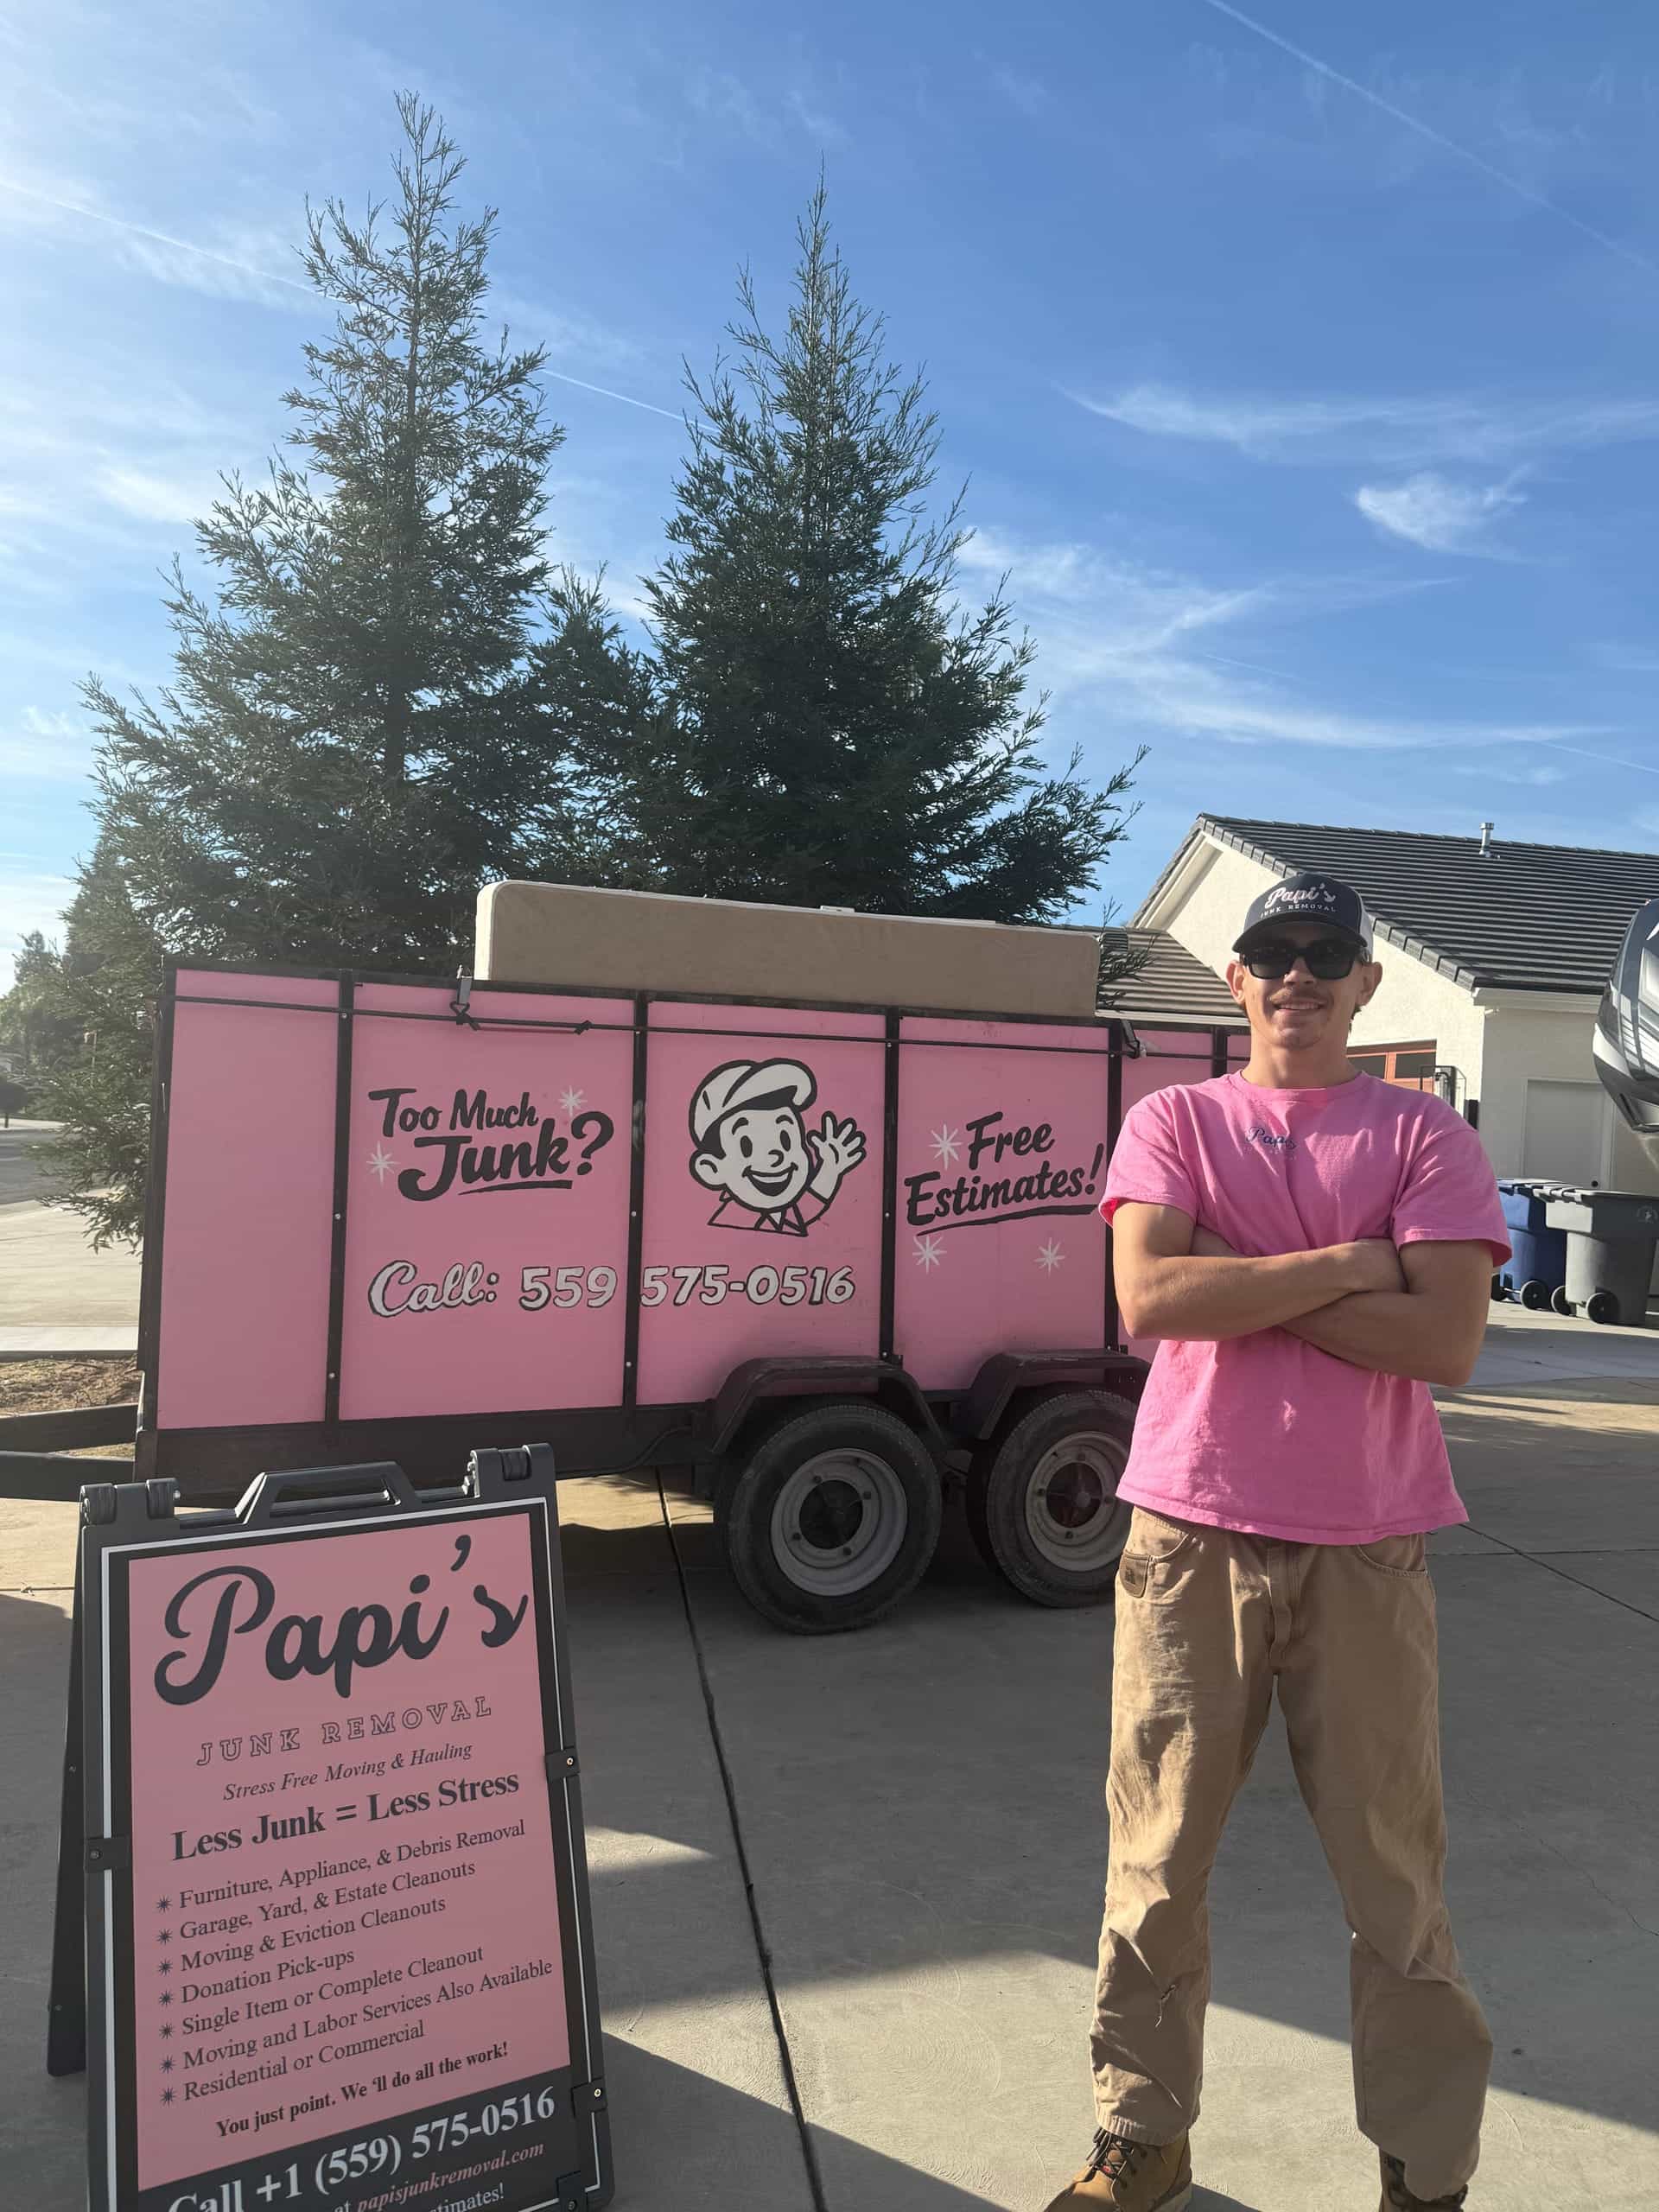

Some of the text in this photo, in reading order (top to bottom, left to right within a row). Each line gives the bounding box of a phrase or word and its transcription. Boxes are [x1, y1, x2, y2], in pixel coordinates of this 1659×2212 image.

[1264, 882, 1336, 909] Papi's
[1288, 904, 1336, 912] REMOVAL
[368, 1088, 538, 1136] Too Much
[966, 1111, 1055, 1170] Free
[398, 1112, 614, 1201] Junk?
[904, 1143, 1104, 1226] Estimates!
[368, 1261, 855, 1318] Call: 559 575-0516
[154, 1535, 528, 1706] Papi's
[196, 1696, 491, 1766] JUNK REMOVAL
[223, 1743, 473, 1801] Stress Free Moving & Hauling
[171, 1774, 518, 1861] Less Junk = Less Stress
[180, 1819, 525, 1908] Furniture, Appliance, & Debris Removal
[180, 1862, 475, 1939] Garage, Yard, & Estate Cleanouts
[181, 1898, 446, 1971] Moving & Eviction Cleanouts
[181, 1950, 354, 2003] Donation Pick-ups
[182, 1946, 483, 2035] Single Item or Complete Cleanout
[183, 1960, 553, 2069] Moving and Labor Services Also Available
[183, 2019, 424, 2101] Residential or Commercial
[216, 2119, 249, 2137] You
[254, 2107, 284, 2132] just
[289, 2094, 336, 2121] point.
[392, 2072, 410, 2088] do
[416, 2062, 435, 2081] all
[438, 2057, 462, 2075] the
[467, 2041, 508, 2066] work!
[256, 2163, 302, 2202] +1
[315, 2134, 401, 2195] (559)
[411, 2085, 555, 2158] 575-0516
[358, 2143, 544, 2212] papisjunkremoval.com
